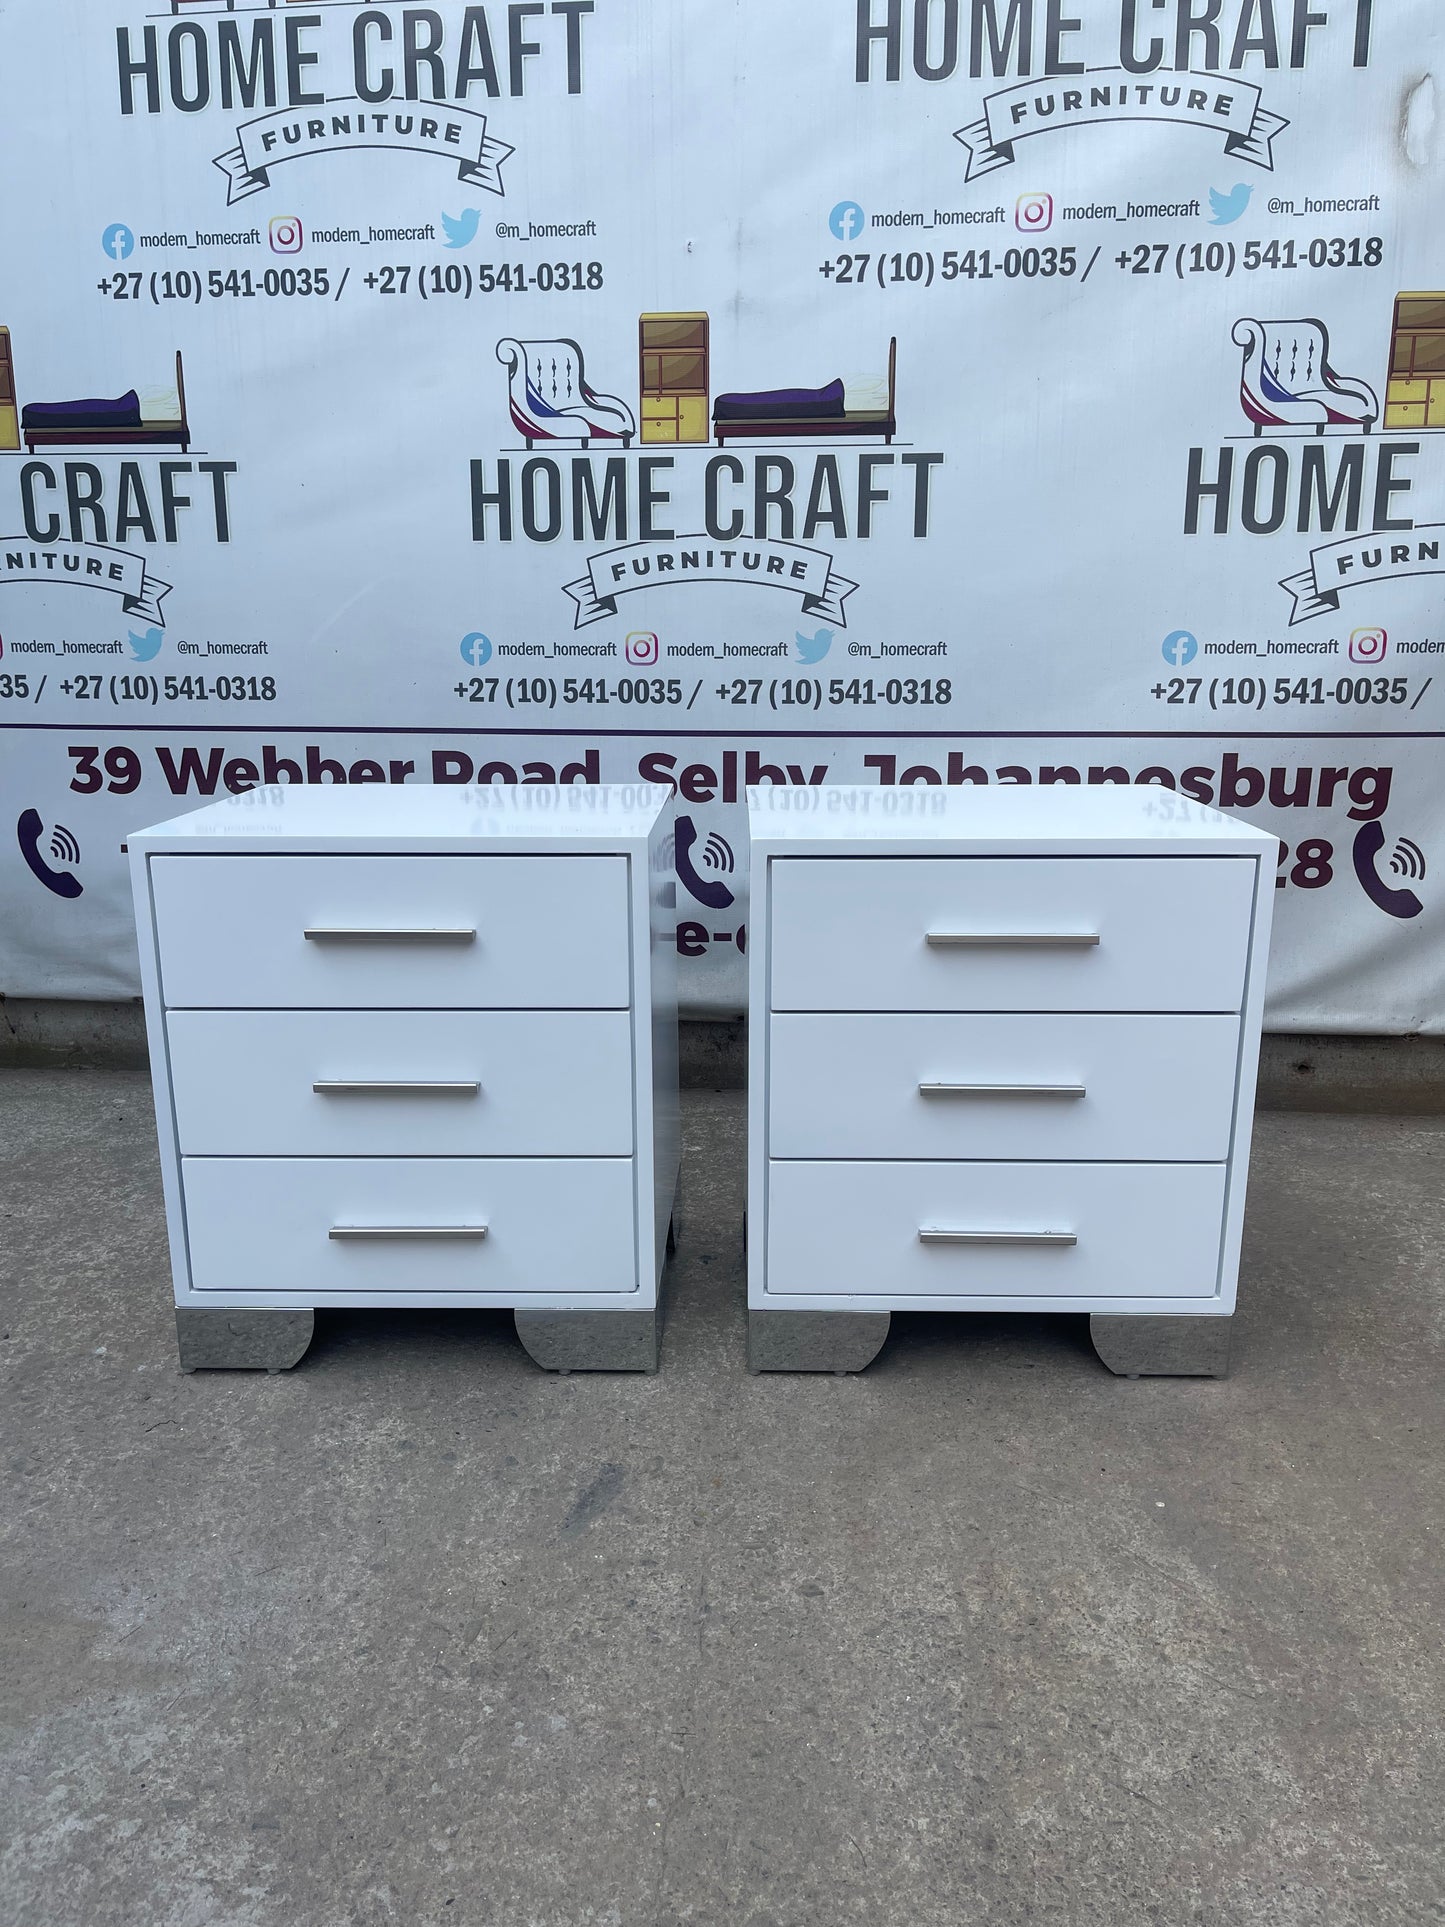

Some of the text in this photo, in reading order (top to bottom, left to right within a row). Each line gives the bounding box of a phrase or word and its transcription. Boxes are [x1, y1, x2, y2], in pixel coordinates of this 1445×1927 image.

[116, 0, 595, 115] HOME CRAFT
[855, 0, 1372, 83] HOME CRAFT
[1011, 86, 1236, 125] FURNITURE
[261, 114, 463, 152] FURNITURE
[871, 195, 1381, 229] modern_homecraft modern_homecraft @m_homecraft
[139, 219, 597, 248] modern_homecraft modern_homecraft @m_homecraft
[818, 254, 871, 284] +27
[877, 252, 935, 289] (10)
[941, 246, 1077, 281] 541-0035
[1114, 244, 1170, 275] +27
[1175, 241, 1236, 280] (10)
[1242, 236, 1383, 271] 541-0318
[97, 272, 143, 300] +27
[149, 270, 202, 305] (10)
[208, 268, 330, 298] 541-0035
[363, 265, 411, 294] +27
[418, 264, 473, 300] (10)
[478, 261, 604, 293] 541-0318
[20, 461, 238, 544] CRAFT
[469, 452, 944, 542] HOME CRAFT
[1183, 442, 1421, 535] HOME
[0, 551, 125, 582] NITURE
[611, 550, 809, 582] FURNITURE
[1336, 541, 1439, 576] FURN
[10, 639, 269, 657] modern_homecraft @m_homecraft
[498, 641, 948, 660] modern_homecraft modern_homecraft @m_homecraft
[1204, 638, 1340, 658] modern_homecraft
[0, 674, 30, 699] 35
[59, 675, 103, 700] +27
[109, 675, 159, 706] (10)
[164, 675, 277, 701] 541-0318
[453, 677, 500, 703] +27
[505, 677, 557, 709] (10)
[562, 678, 683, 705] 541-0035
[715, 678, 763, 705] +27
[769, 678, 822, 711] (10)
[828, 678, 952, 705] 541-0318
[1150, 677, 1203, 704] +27
[1208, 677, 1267, 711] (10)
[1272, 677, 1408, 705] 541-0035
[67, 745, 142, 795] 39
[154, 745, 416, 796] Webber
